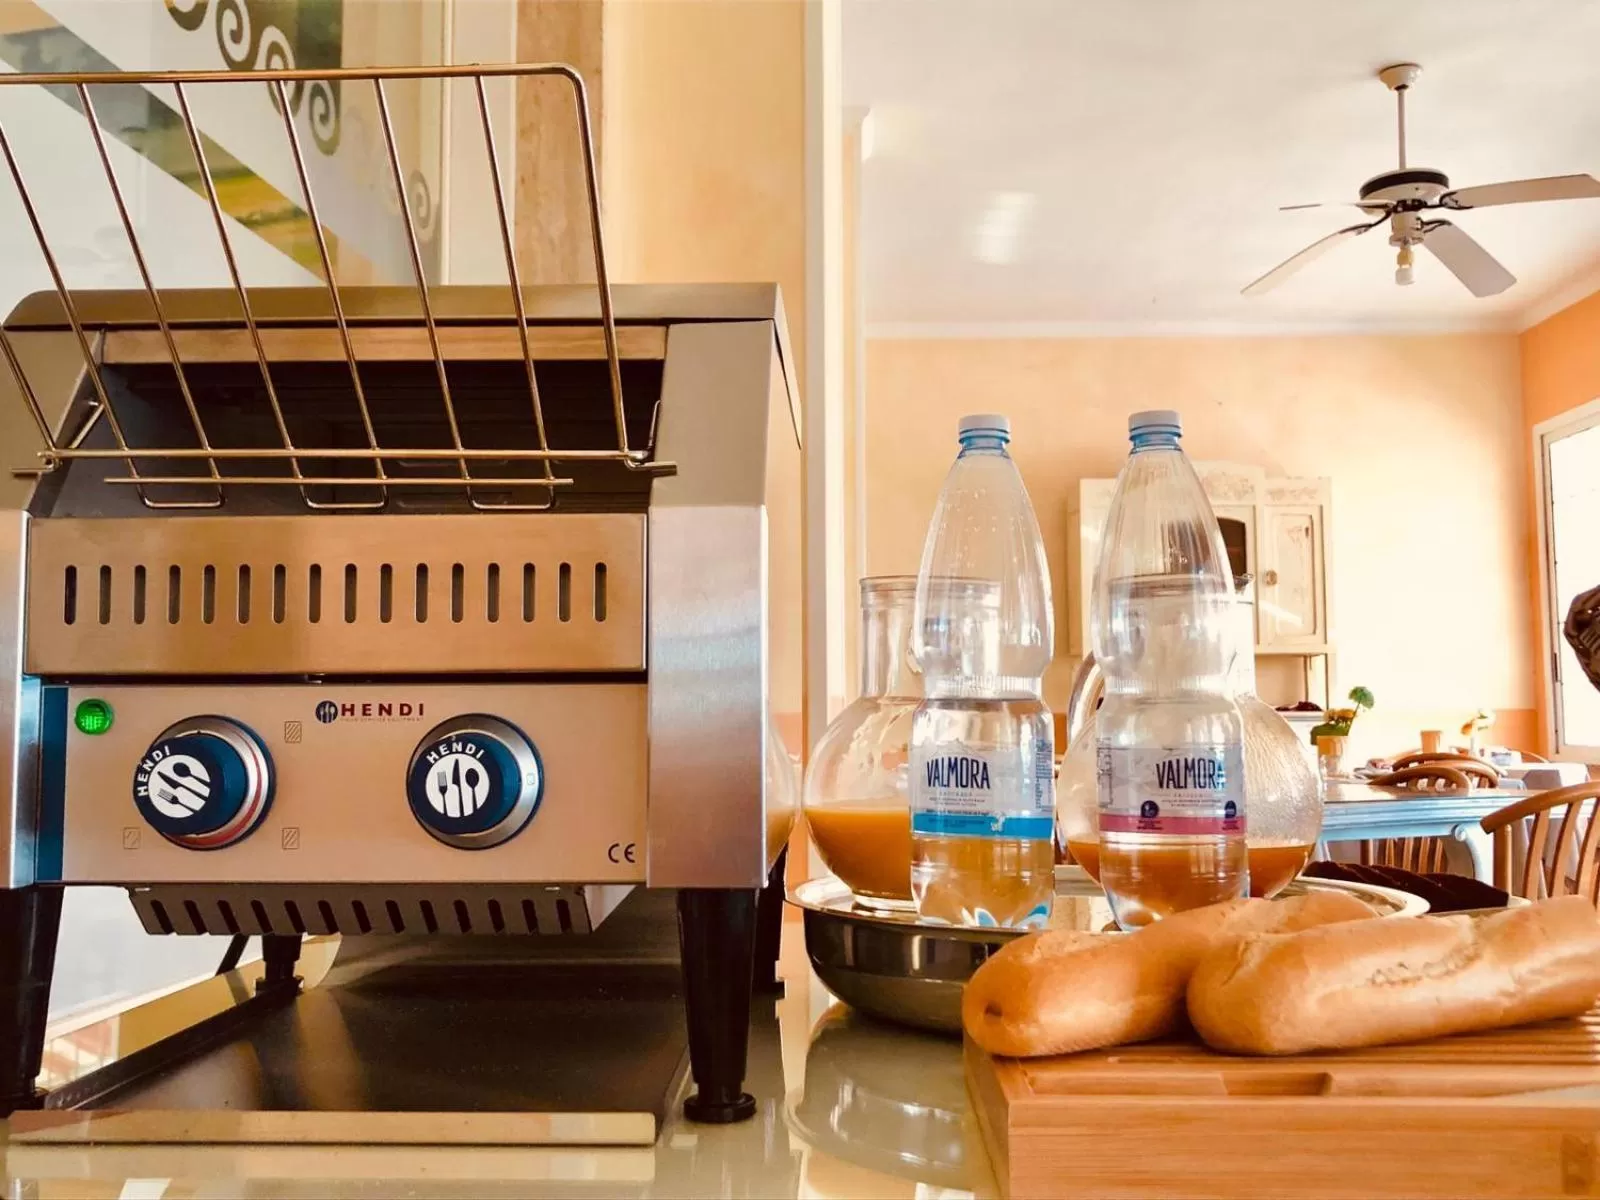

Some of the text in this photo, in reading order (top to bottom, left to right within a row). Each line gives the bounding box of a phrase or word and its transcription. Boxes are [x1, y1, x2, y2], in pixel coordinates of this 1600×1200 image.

[341, 703, 424, 716] HENDI
[426, 741, 485, 764] HENDI
[136, 745, 170, 797] HENDI
[926, 757, 990, 789] VALMORA
